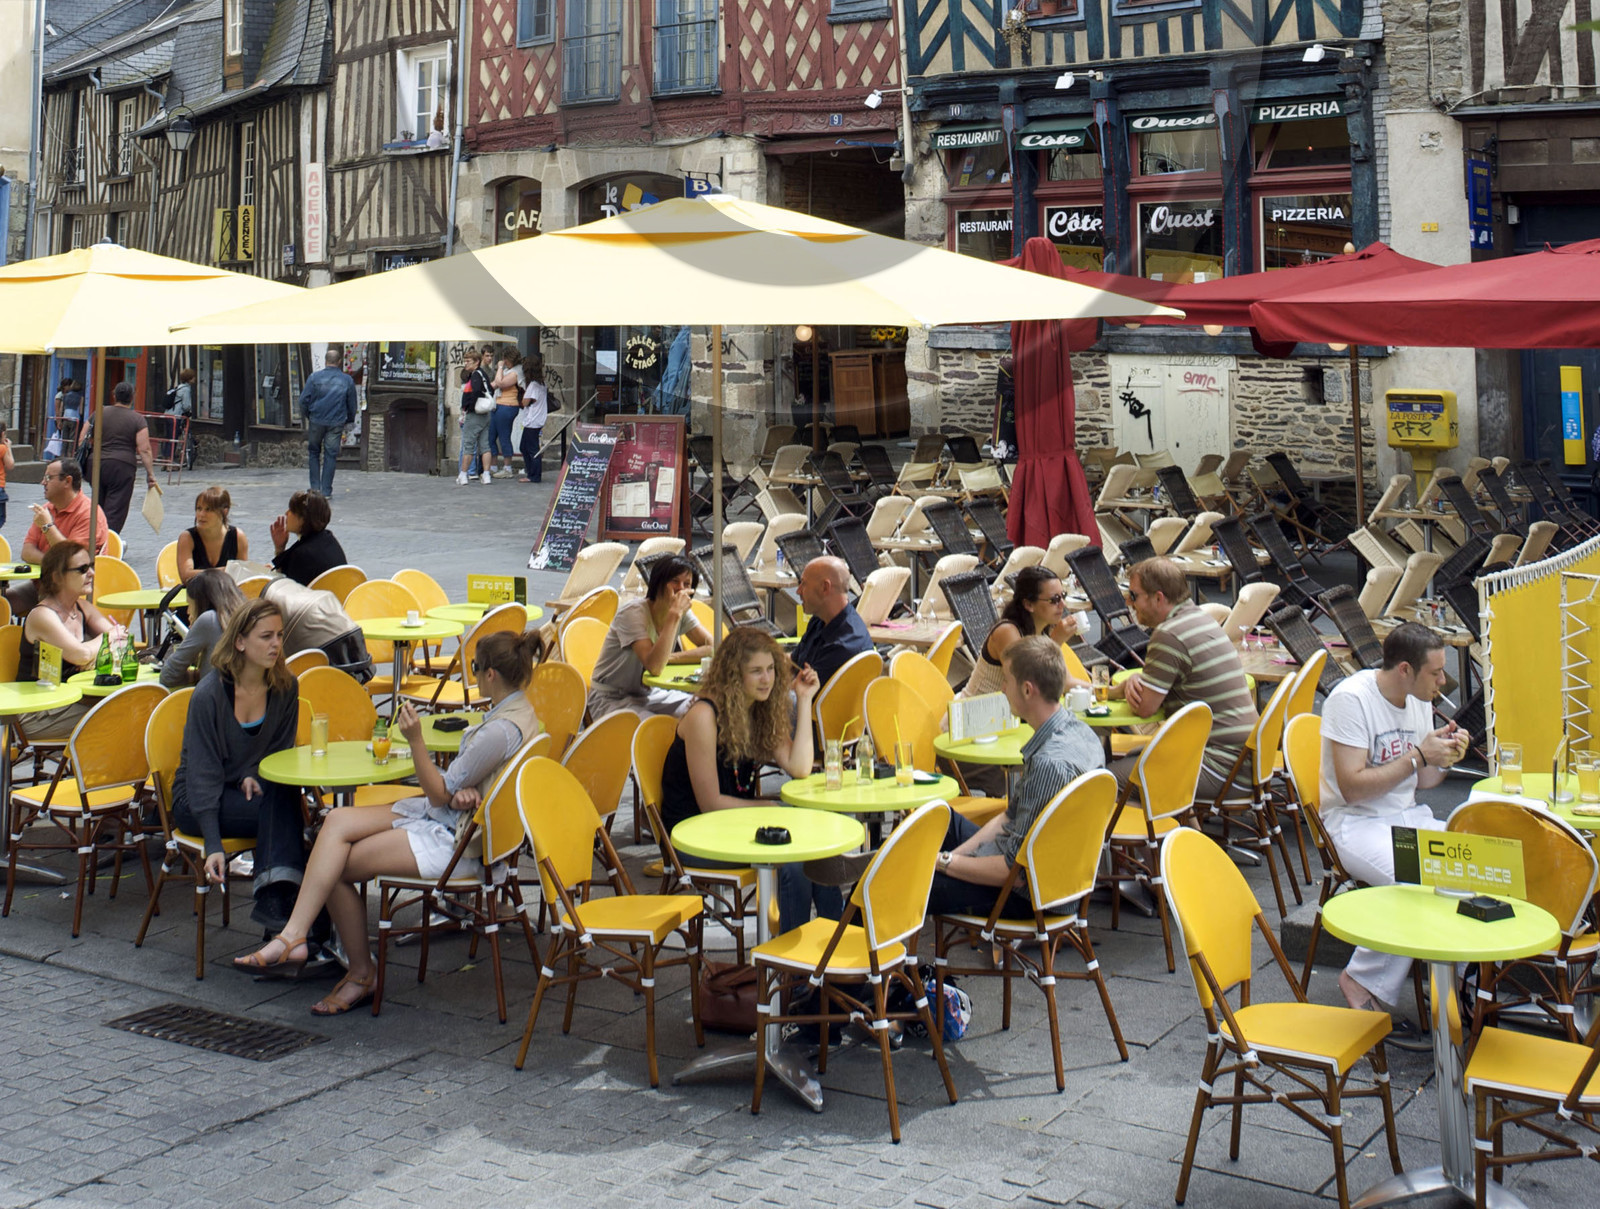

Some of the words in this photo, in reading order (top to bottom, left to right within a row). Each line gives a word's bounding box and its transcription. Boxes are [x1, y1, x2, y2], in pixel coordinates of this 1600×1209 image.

[833, 114, 839, 125] 9
[950, 105, 961, 117] 10
[1258, 101, 1341, 121] PIZZERIA
[1131, 113, 1217, 130] Ouest
[937, 129, 1001, 147] RESTAURANT
[1020, 133, 1082, 148] Côte
[605, 182, 618, 204] le
[307, 171, 321, 255] AGENCE
[1150, 205, 1216, 234] Ouest
[1272, 206, 1345, 222] PIZZERIA
[241, 208, 251, 249] AGENCE
[959, 219, 1013, 234] RESTAURANT
[1048, 210, 1103, 238] Côte
[625, 334, 657, 351] SALLES
[637, 348, 644, 358] A
[1390, 412, 1401, 420] LA
[1402, 412, 1428, 421] POSTE
[1428, 839, 1473, 861] Café
